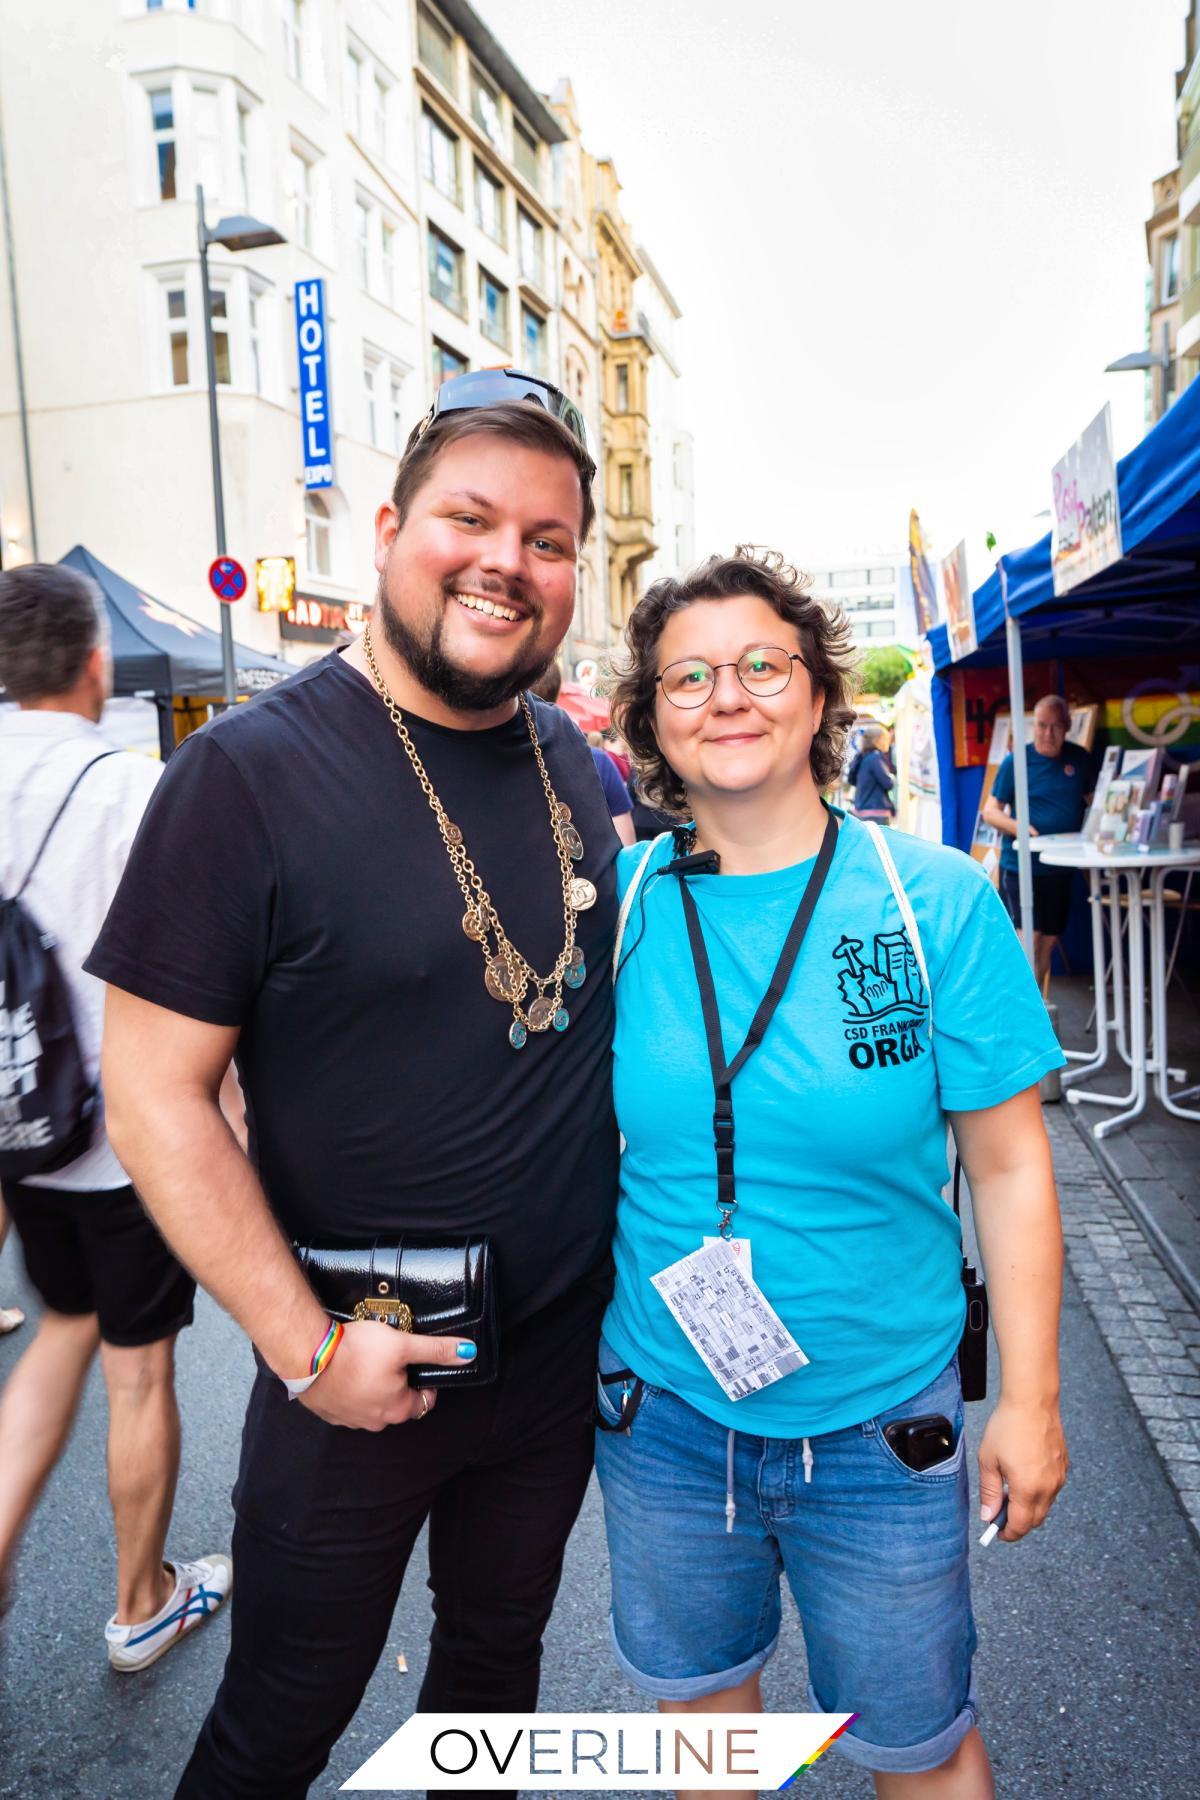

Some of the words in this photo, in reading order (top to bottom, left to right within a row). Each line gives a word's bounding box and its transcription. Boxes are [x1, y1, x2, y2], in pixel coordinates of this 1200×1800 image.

[297, 282, 327, 458] HOTEL
[844, 1027, 868, 1041] CSD
[848, 1028, 926, 1070] ORGA
